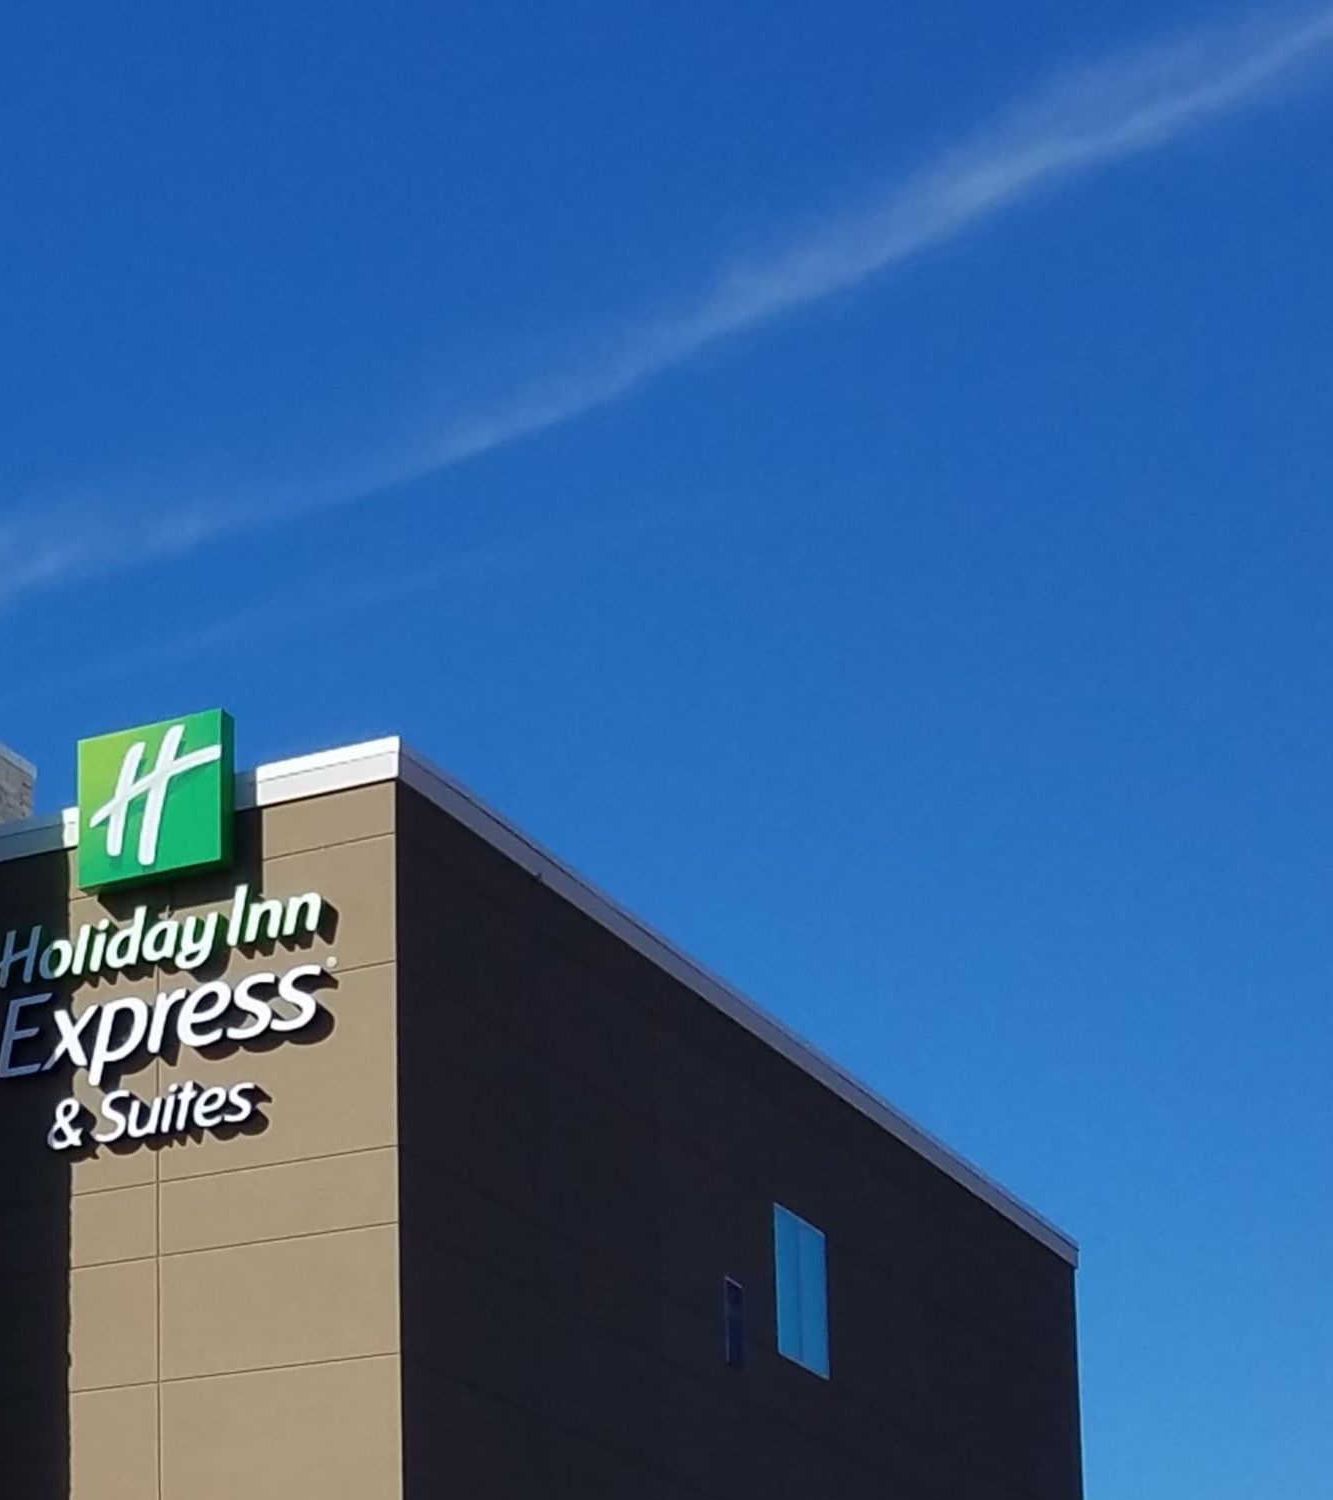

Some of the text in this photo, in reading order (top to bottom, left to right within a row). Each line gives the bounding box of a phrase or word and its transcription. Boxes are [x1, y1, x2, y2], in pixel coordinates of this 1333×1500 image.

[226, 883, 321, 946] Inn
[47, 1080, 255, 1150] & Suites
